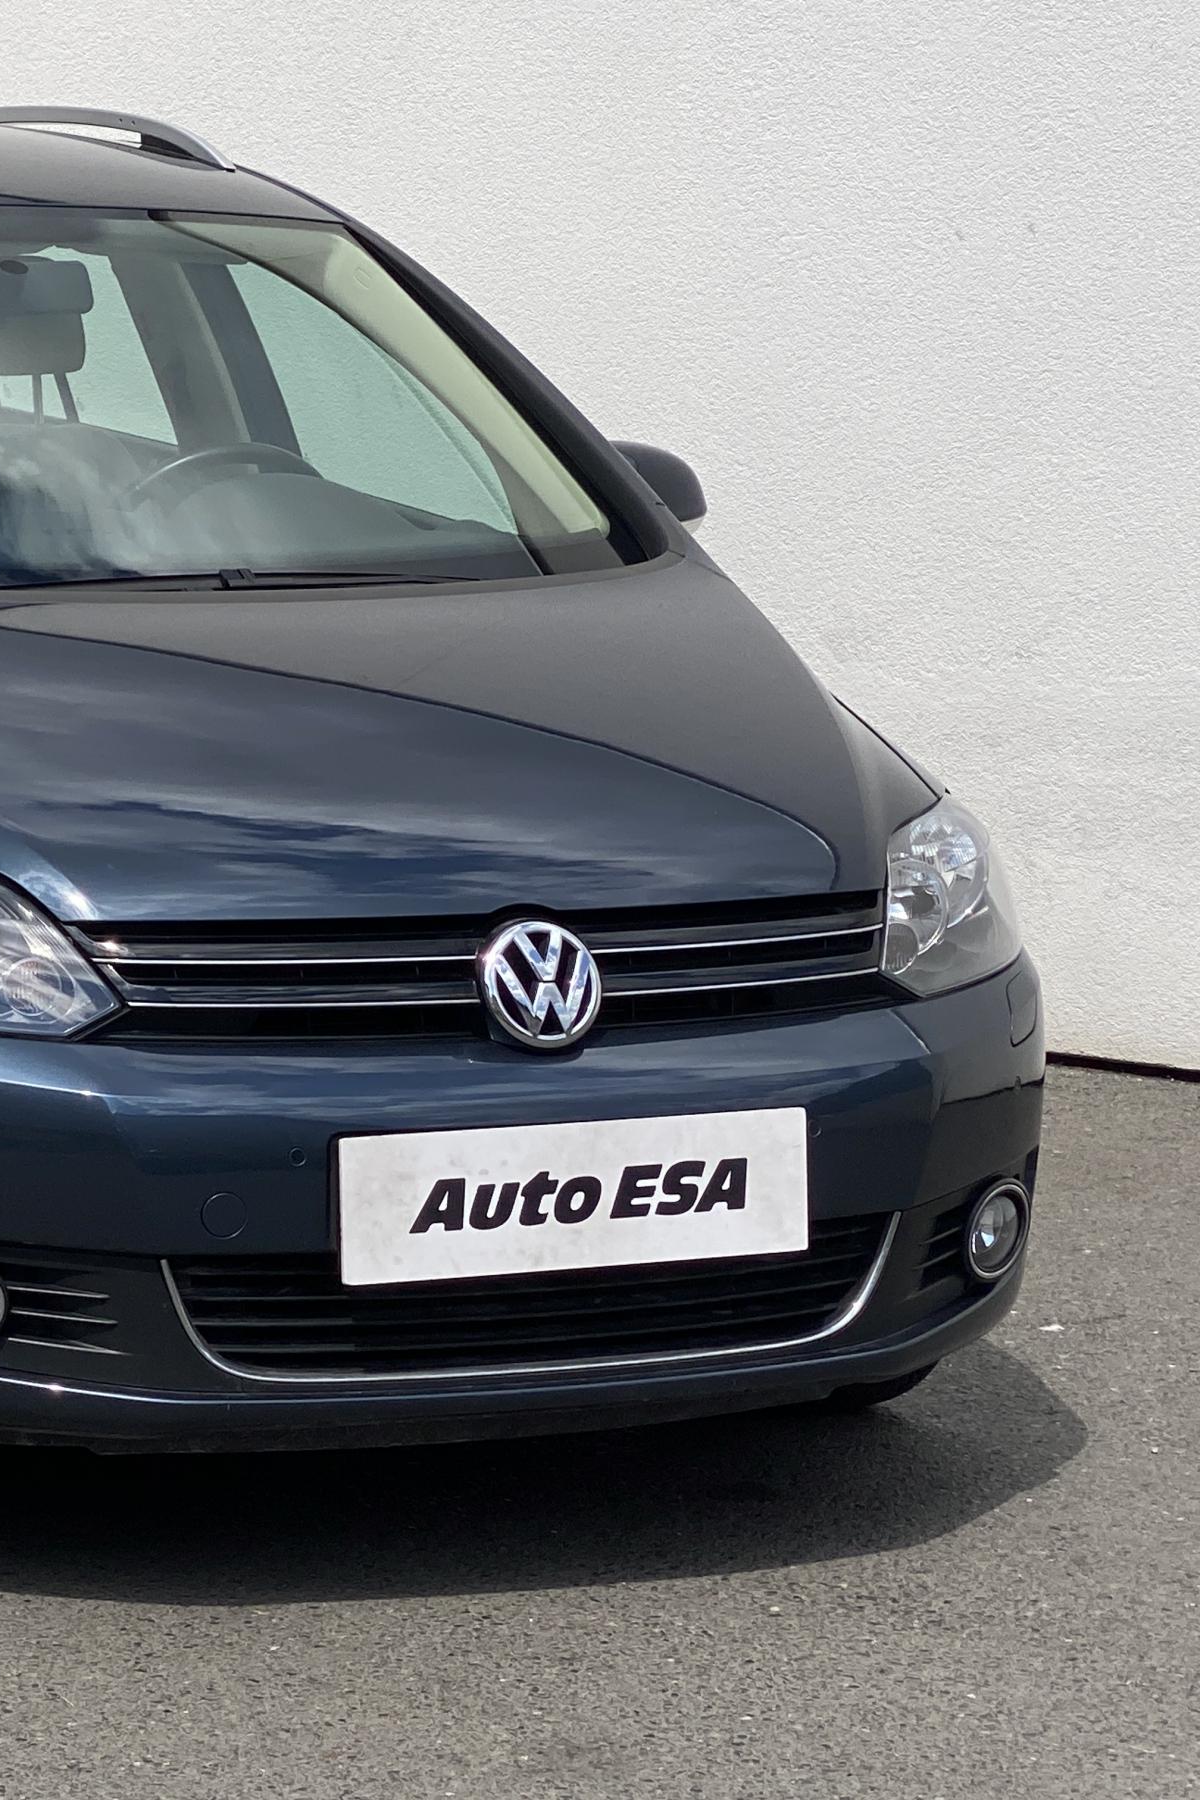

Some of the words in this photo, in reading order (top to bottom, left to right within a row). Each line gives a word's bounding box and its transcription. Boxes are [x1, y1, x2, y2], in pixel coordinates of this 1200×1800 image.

[485, 921, 599, 1043] VW
[409, 1171, 602, 1234] Auto
[610, 1158, 748, 1219] ESA
